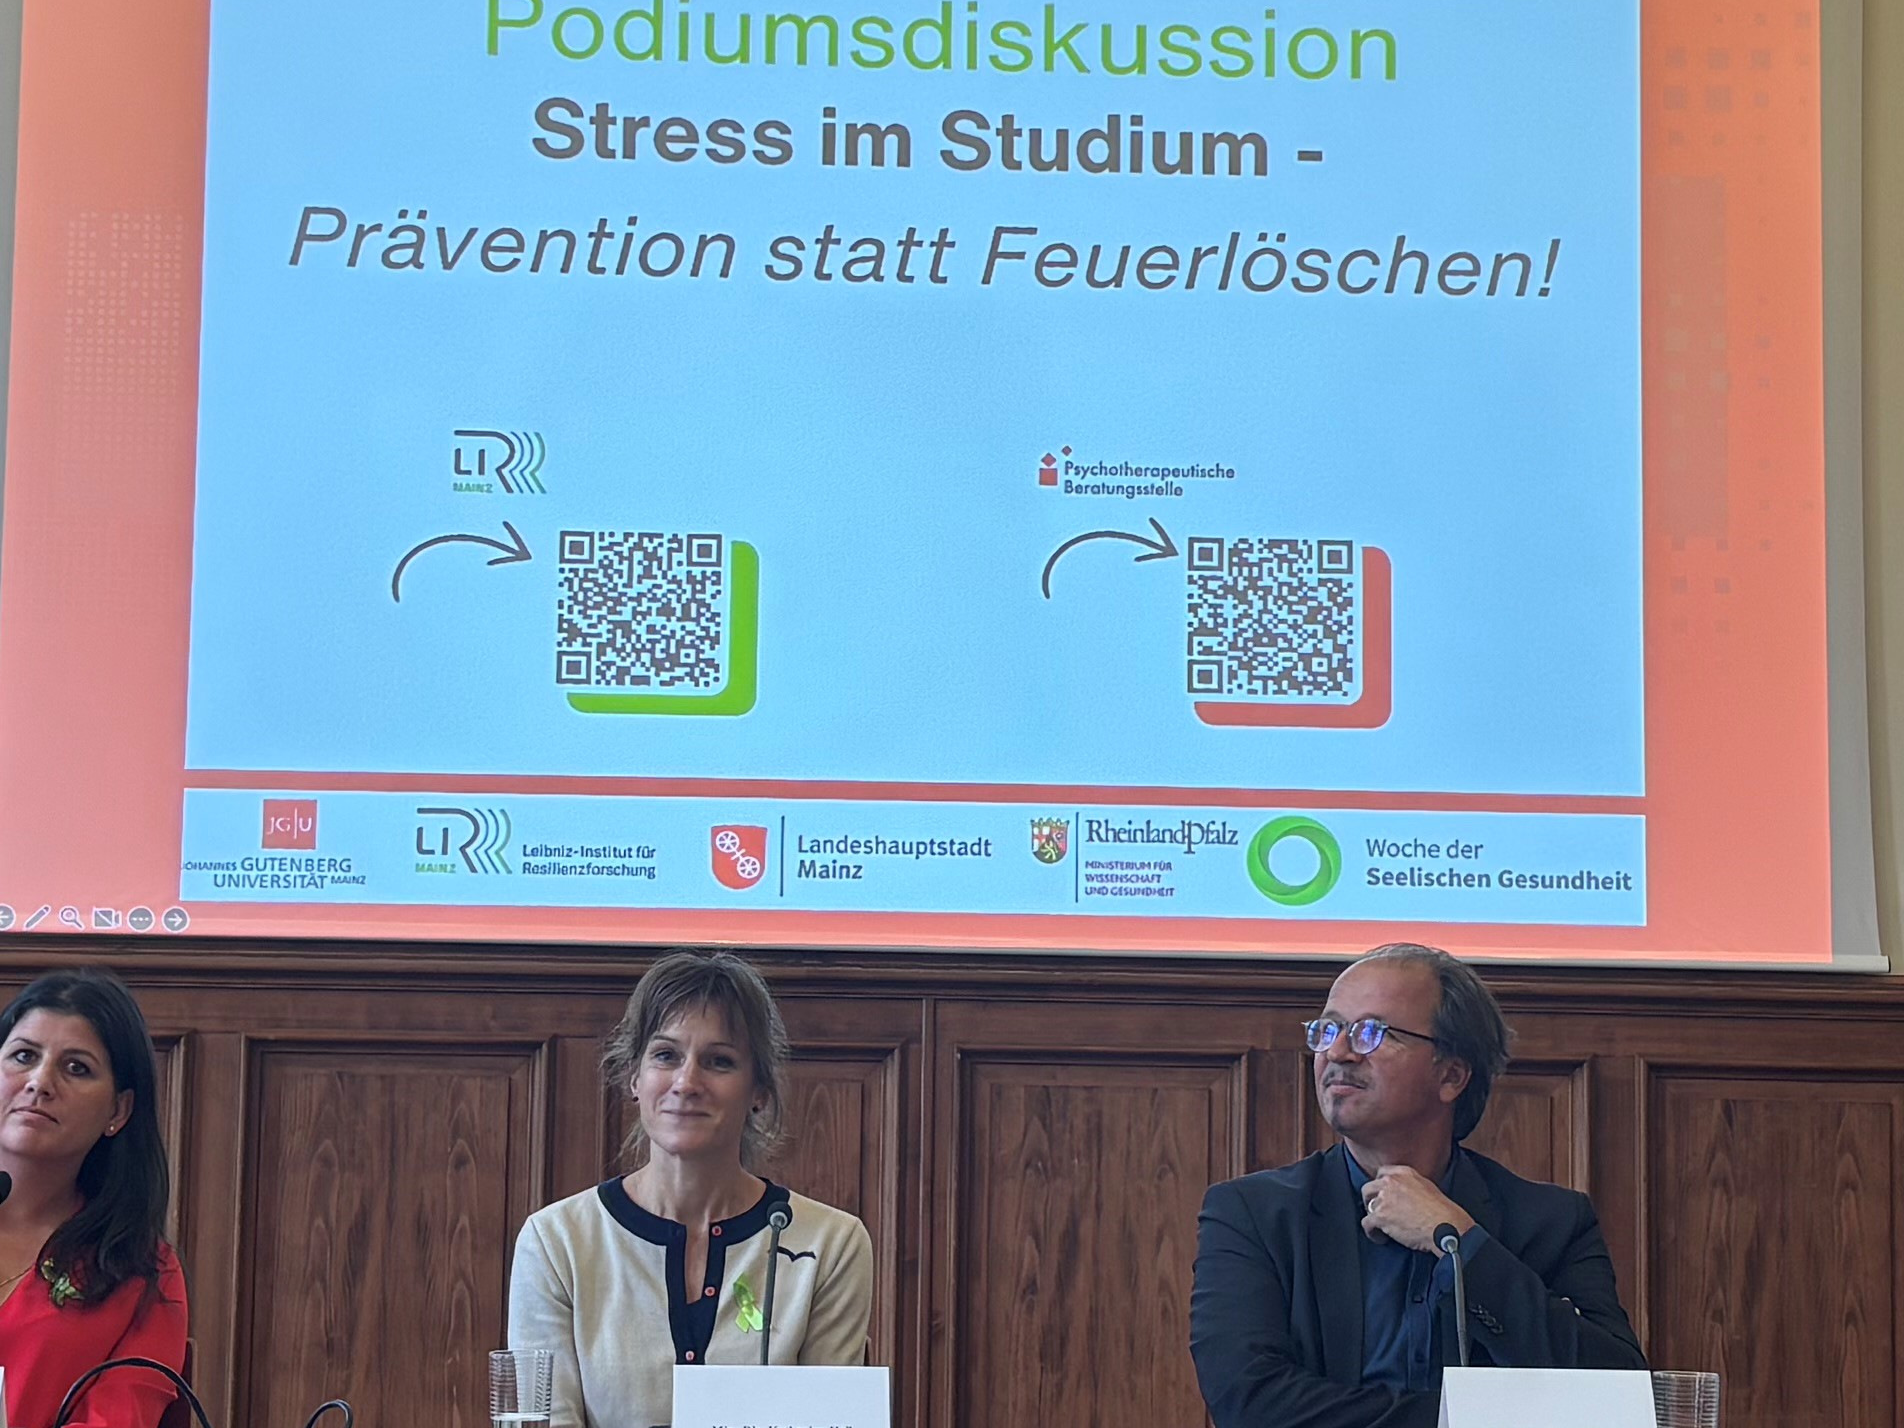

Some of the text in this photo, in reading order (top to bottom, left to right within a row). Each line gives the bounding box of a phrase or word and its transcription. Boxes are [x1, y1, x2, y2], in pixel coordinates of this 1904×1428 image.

[532, 97, 794, 166] Stress
[822, 107, 912, 168] im
[939, 109, 1269, 177] Studium
[288, 205, 1561, 298] Prävention statt Feuerlöschen!
[1064, 460, 1235, 481] Psychotherapeutische
[1063, 479, 1184, 500] Beratungsstelle
[522, 843, 657, 859] Leibniz-Institut für
[797, 834, 993, 860] Landeshauptstadt
[1365, 837, 1484, 859] Woche der
[240, 856, 352, 873] GUTENBERG
[415, 862, 457, 874] MAINZ
[522, 861, 657, 880] Resilienzforschung
[797, 859, 863, 880] Mainz
[1084, 860, 1173, 871] MINISTERIUM FÜR
[213, 871, 367, 889] UNIVERSITÄT MAINZ
[1084, 873, 1162, 884] WISSENSCHAFT
[1365, 867, 1633, 891] Seelischen Gesundheit
[1084, 885, 1175, 897] UND GESUNDHEIT
